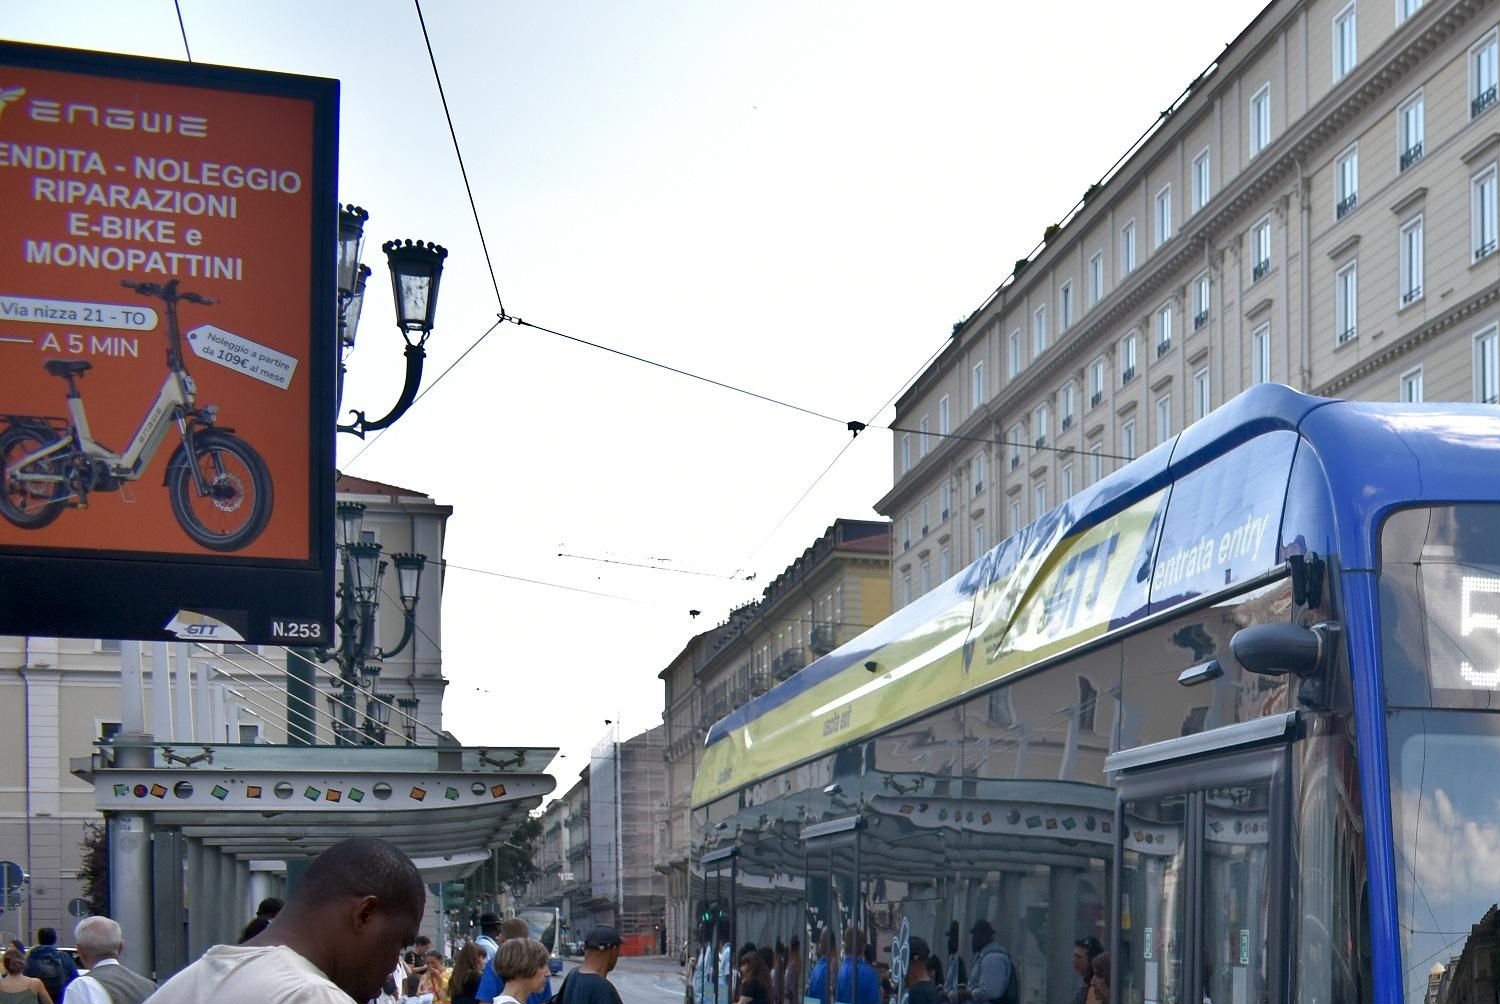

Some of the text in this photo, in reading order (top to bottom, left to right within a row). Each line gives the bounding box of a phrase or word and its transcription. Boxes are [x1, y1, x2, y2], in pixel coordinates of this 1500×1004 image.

[135, 156, 302, 194] NOLEGGIO
[34, 177, 238, 219] RIPARAZIONI
[69, 212, 202, 247] E-BIKE e
[24, 239, 243, 281] MONOPATTINI
[1, 302, 28, 317] Via
[34, 304, 78, 321] nizza
[83, 308, 105, 323] 21
[122, 310, 146, 326] TO
[41, 332, 139, 358] A 5 MIN
[207, 332, 250, 355] Noleggio
[258, 354, 290, 371] partire
[202, 345, 286, 384] da 109€ al mese
[1153, 513, 1270, 592] entrata entry
[185, 623, 219, 636] GTT
[273, 621, 321, 638] N.253
